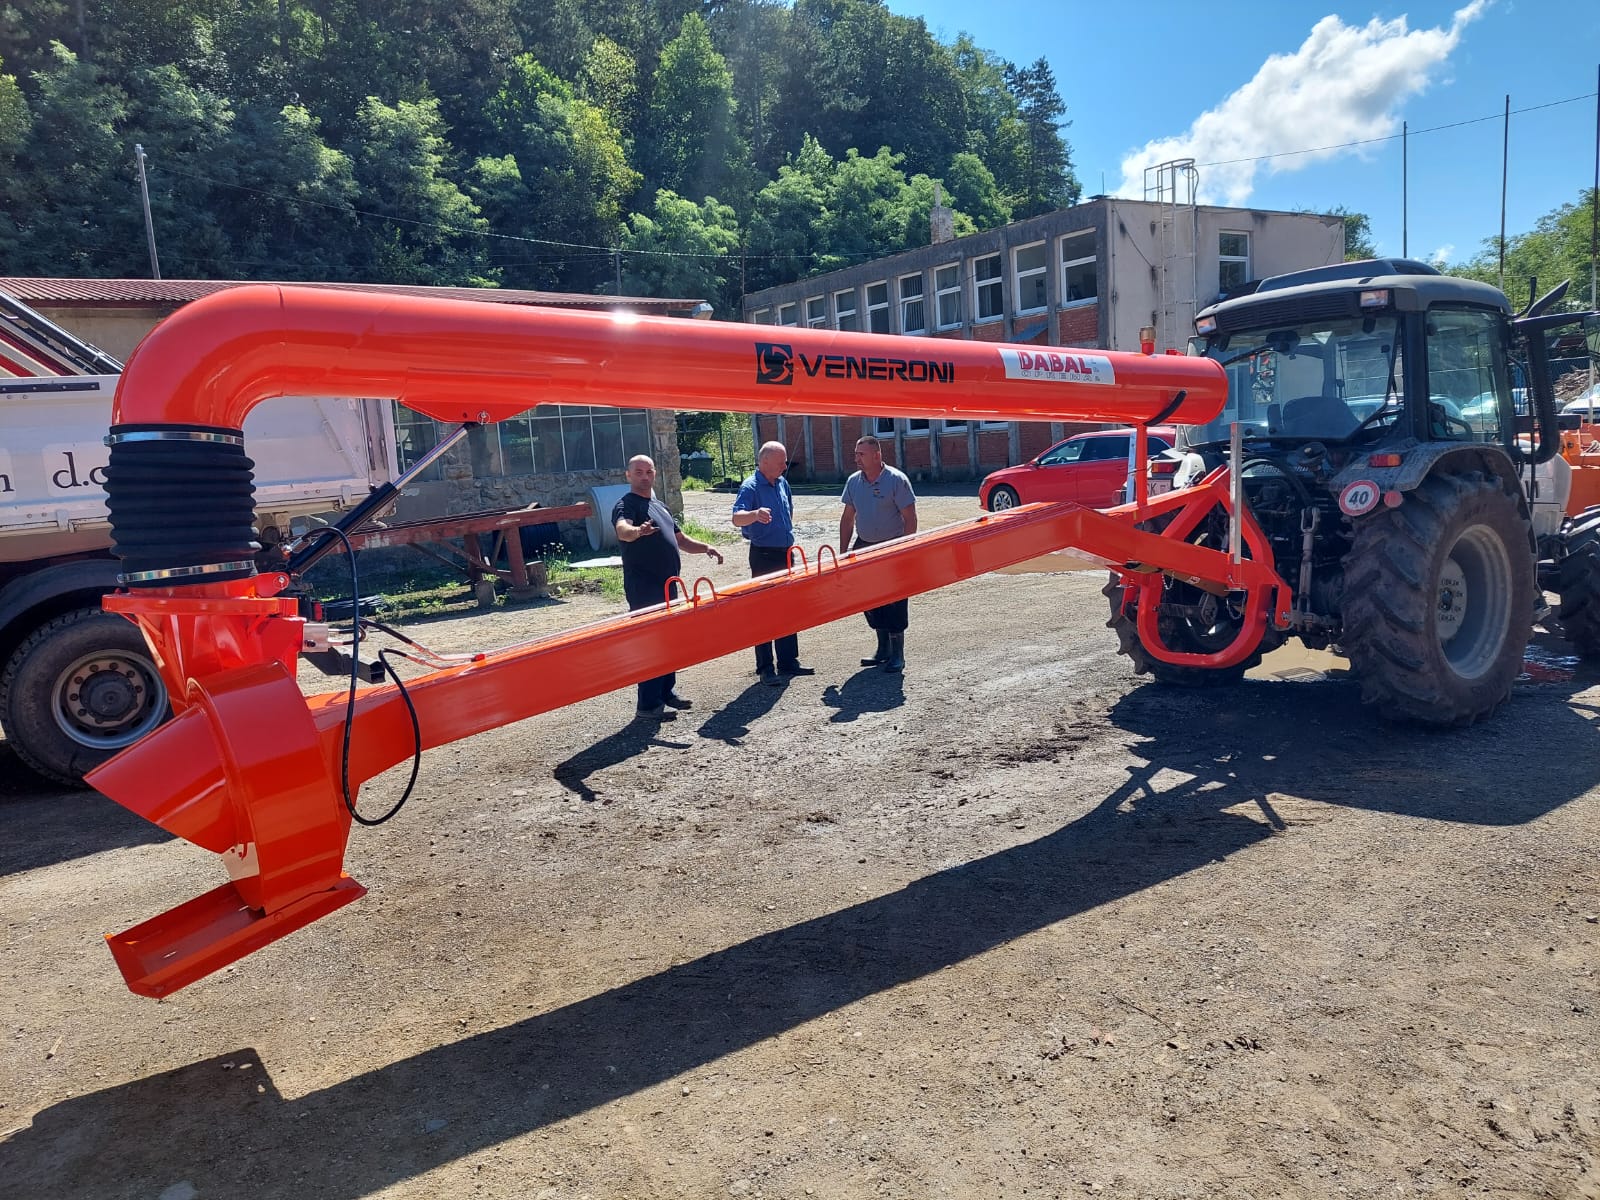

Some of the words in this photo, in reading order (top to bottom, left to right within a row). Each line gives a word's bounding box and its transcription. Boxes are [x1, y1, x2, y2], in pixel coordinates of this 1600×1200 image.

[798, 353, 955, 384] VENERONI
[1017, 351, 1093, 375] DABAL
[1348, 490, 1369, 505] 40
